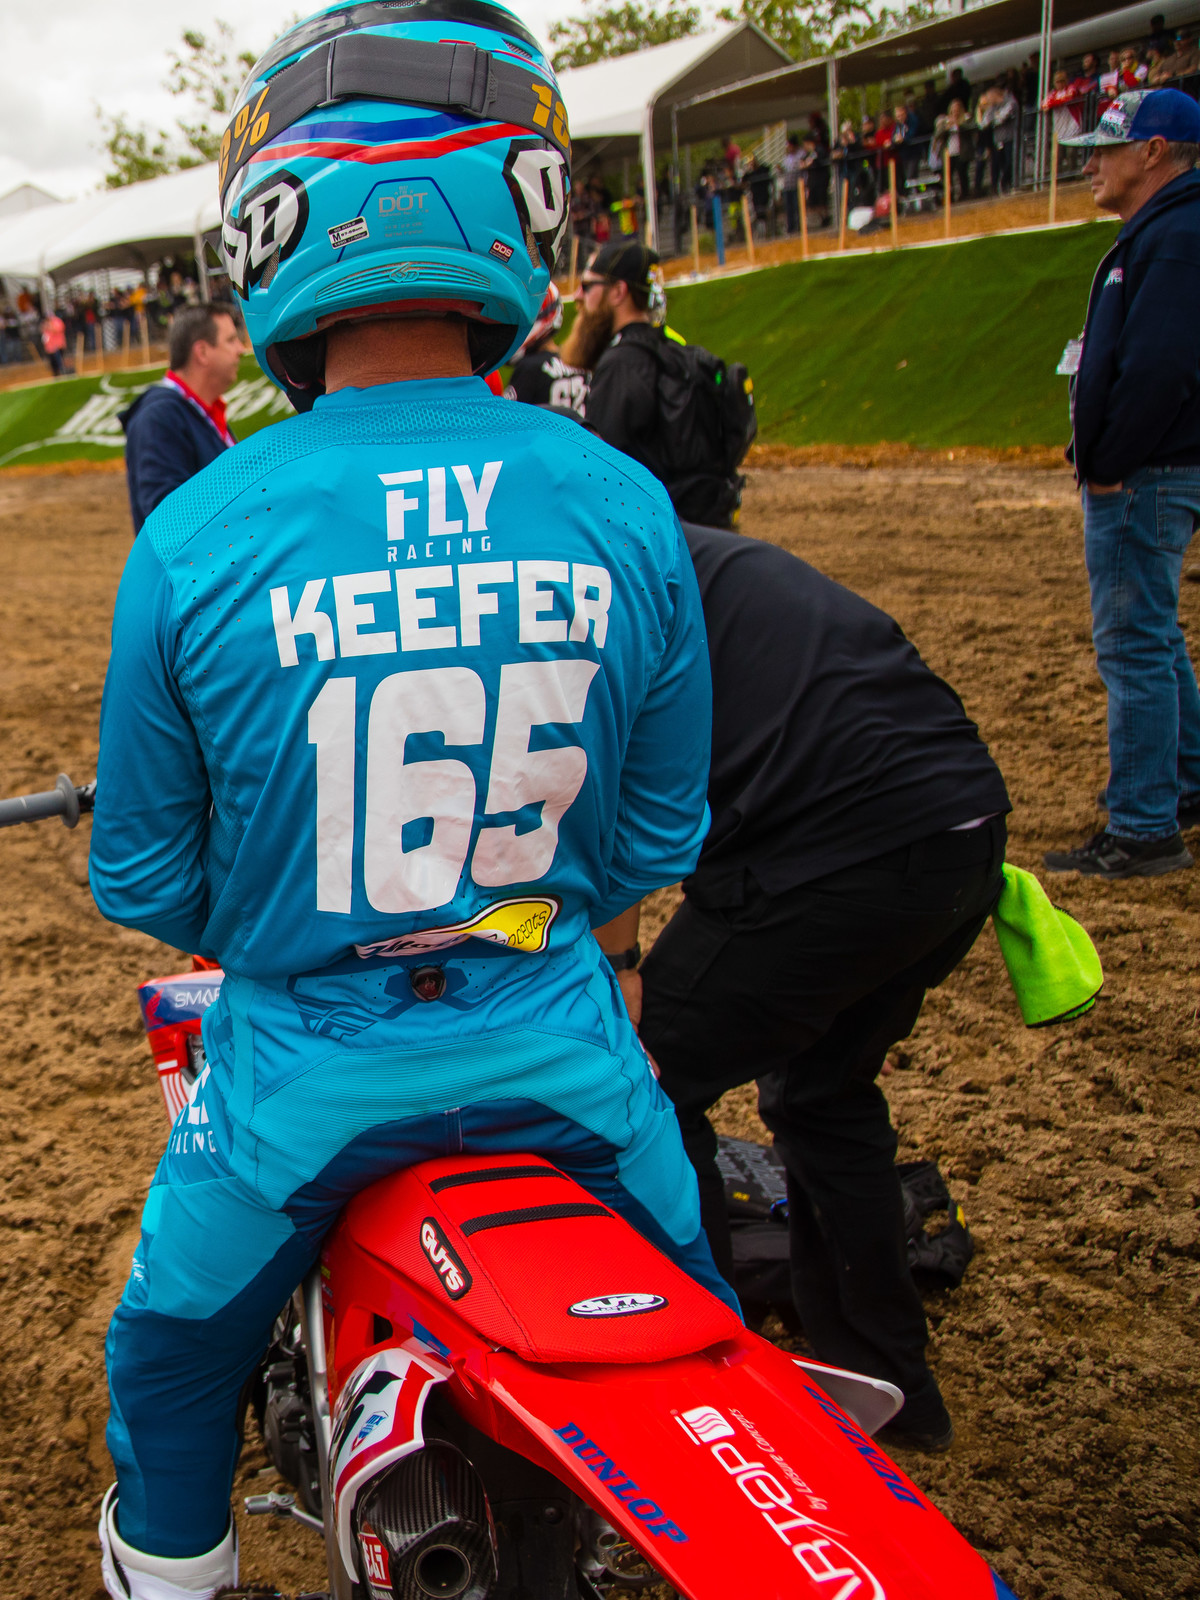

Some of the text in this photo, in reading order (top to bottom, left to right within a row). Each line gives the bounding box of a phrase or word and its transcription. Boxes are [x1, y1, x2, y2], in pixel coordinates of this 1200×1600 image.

[379, 193, 428, 213] DOT
[377, 461, 504, 541] FLY
[387, 536, 492, 562] RACING
[269, 560, 612, 668] KEEFER
[307, 659, 601, 915] 165
[421, 1222, 464, 1292] GUTS
[551, 1422, 691, 1544] DUNLOP
[727, 1406, 829, 1511] by Leisure Concepts
[802, 1384, 928, 1512] DUNLOP
